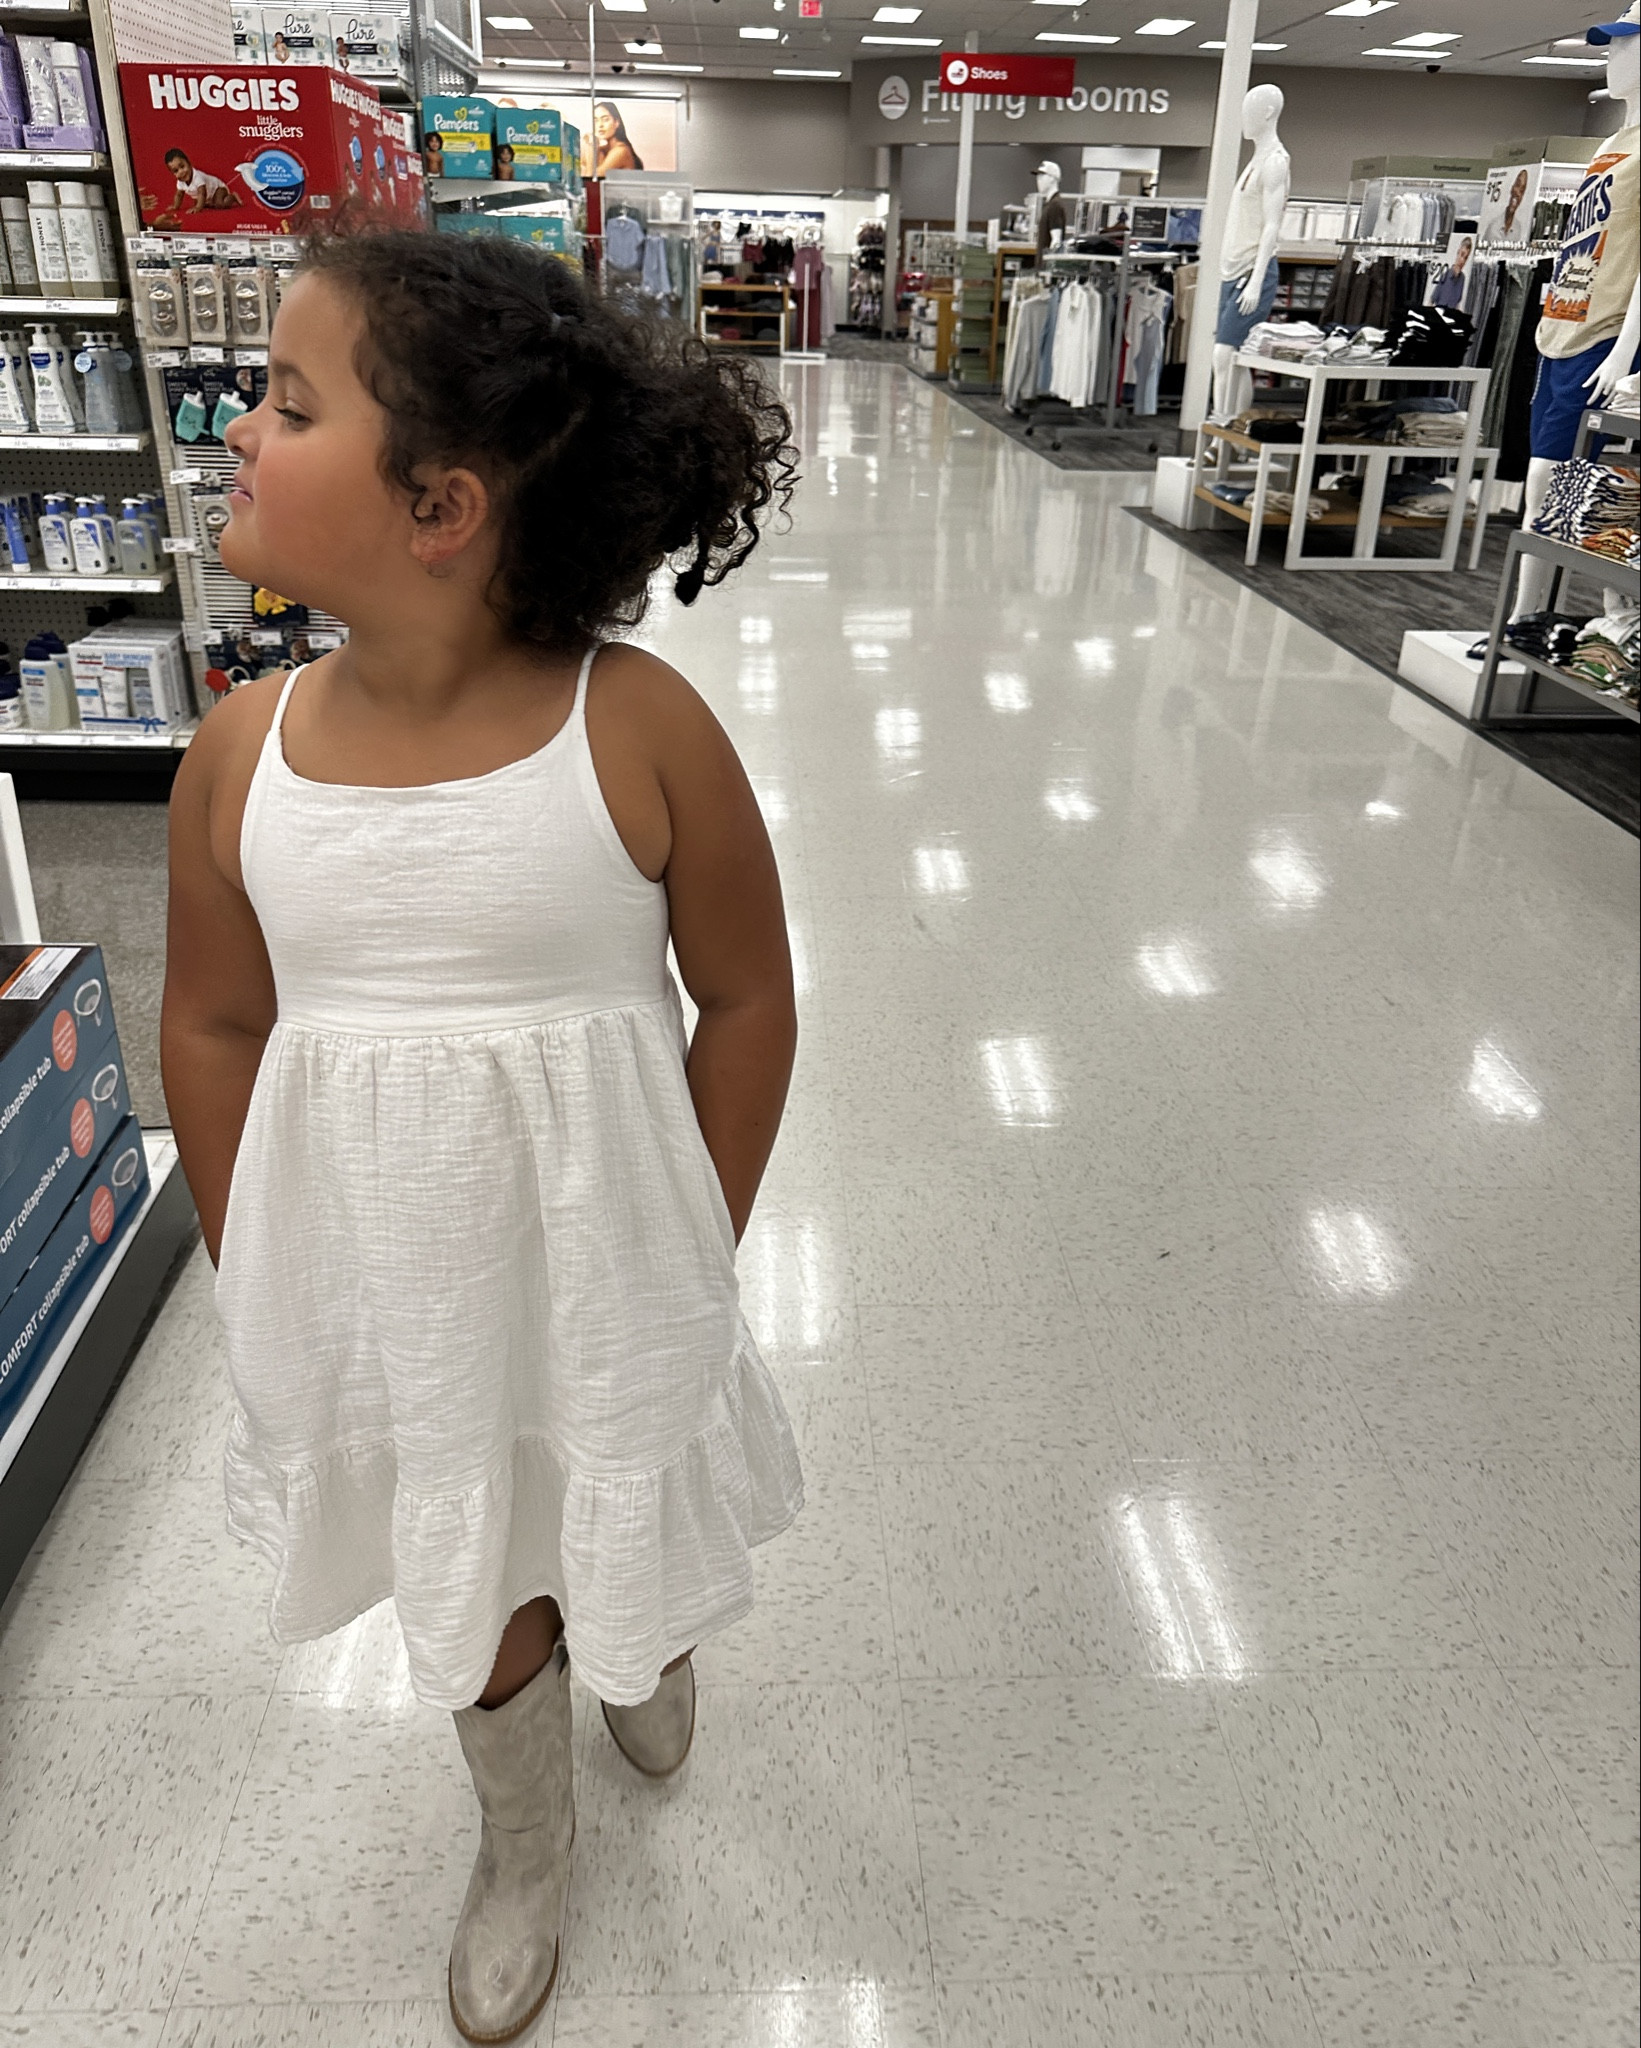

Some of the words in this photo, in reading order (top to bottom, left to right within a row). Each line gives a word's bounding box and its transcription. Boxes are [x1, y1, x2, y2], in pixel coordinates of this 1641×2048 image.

[232, 20, 244, 31] re
[284, 13, 311, 34] Pure
[345, 18, 375, 40] Pure
[970, 66, 1008, 81] Shoes
[148, 73, 300, 112] HUGGIES
[921, 79, 1026, 119] Fiting
[256, 114, 278, 126] little
[433, 112, 480, 132] Pampers
[238, 122, 304, 141] snugglers
[506, 126, 551, 145] Pampers
[36, 217, 46, 246] HONEST
[37, 1056, 52, 1080] tub
[17, 1168, 56, 1228] collapsible
[55, 1146, 70, 1171] tub
[38, 1257, 77, 1321] collapsible
[75, 1234, 90, 1260] tub
